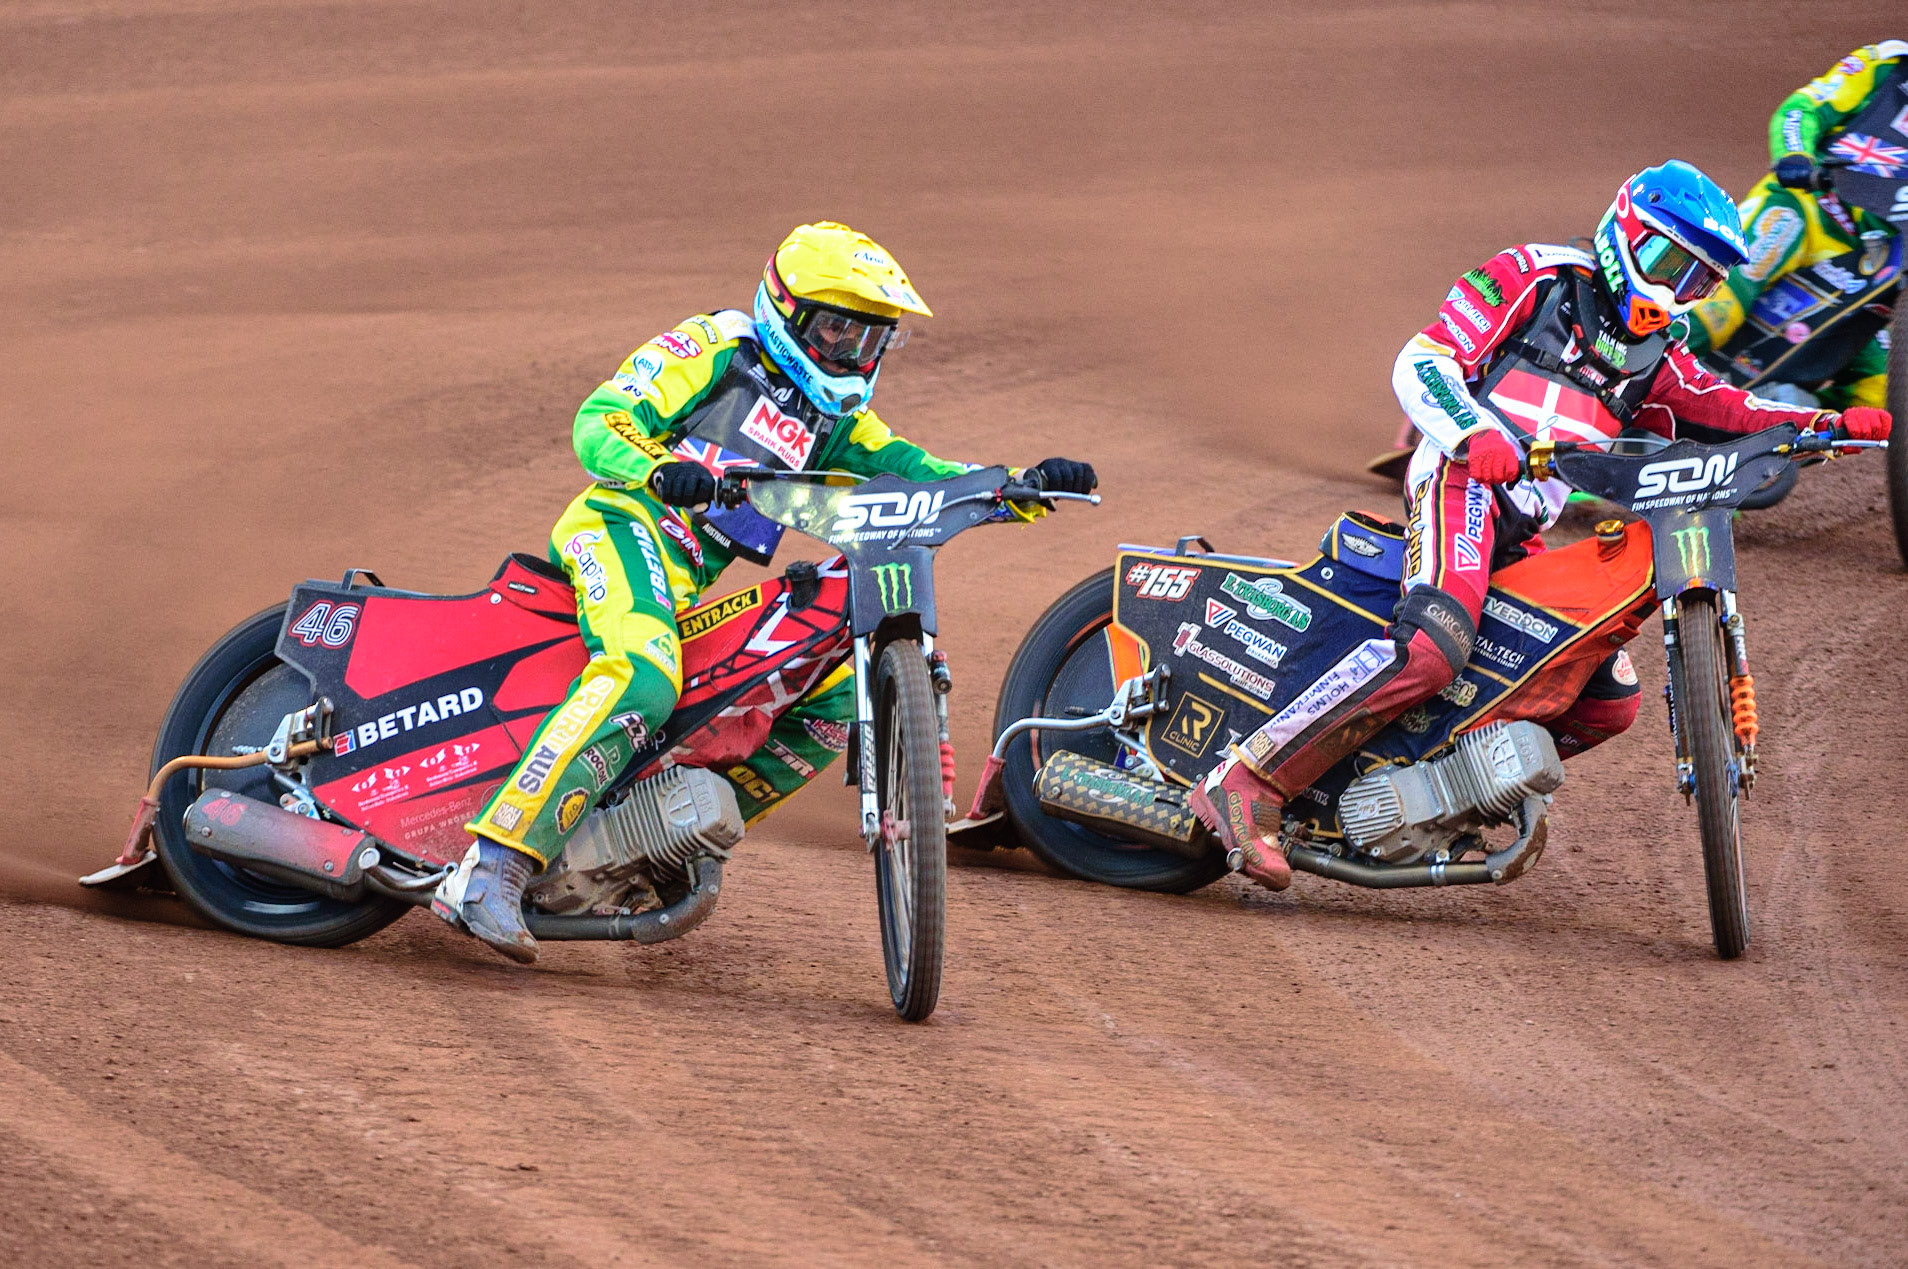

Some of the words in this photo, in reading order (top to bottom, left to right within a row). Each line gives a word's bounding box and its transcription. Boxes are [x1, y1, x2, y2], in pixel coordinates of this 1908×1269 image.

[747, 427, 778, 449] SPARK
[777, 445, 800, 468] PLUGS
[753, 402, 812, 458] NGK
[1631, 501, 1645, 512] FIM
[1644, 495, 1686, 511] SPEEDWAY
[1685, 493, 1696, 504] OF
[702, 523, 732, 549] AUSTRALIA
[843, 530, 886, 543] SPEEDWAY
[886, 529, 899, 540] OF
[1129, 563, 1198, 599] #155
[291, 601, 359, 647] 46
[682, 594, 752, 636] ENTRACK
[1226, 622, 1285, 659] PEGWAN
[1188, 643, 1274, 692] GLASSOLUTIONS
[1307, 681, 1350, 715] HOLMS
[358, 686, 484, 749] BETARD
[1169, 730, 1200, 751] CLINIC
[202, 798, 248, 827] 46
[400, 796, 473, 828] Mercedes-Benz
[1228, 791, 1264, 867] daytona
[404, 825, 436, 840] GRUPA
